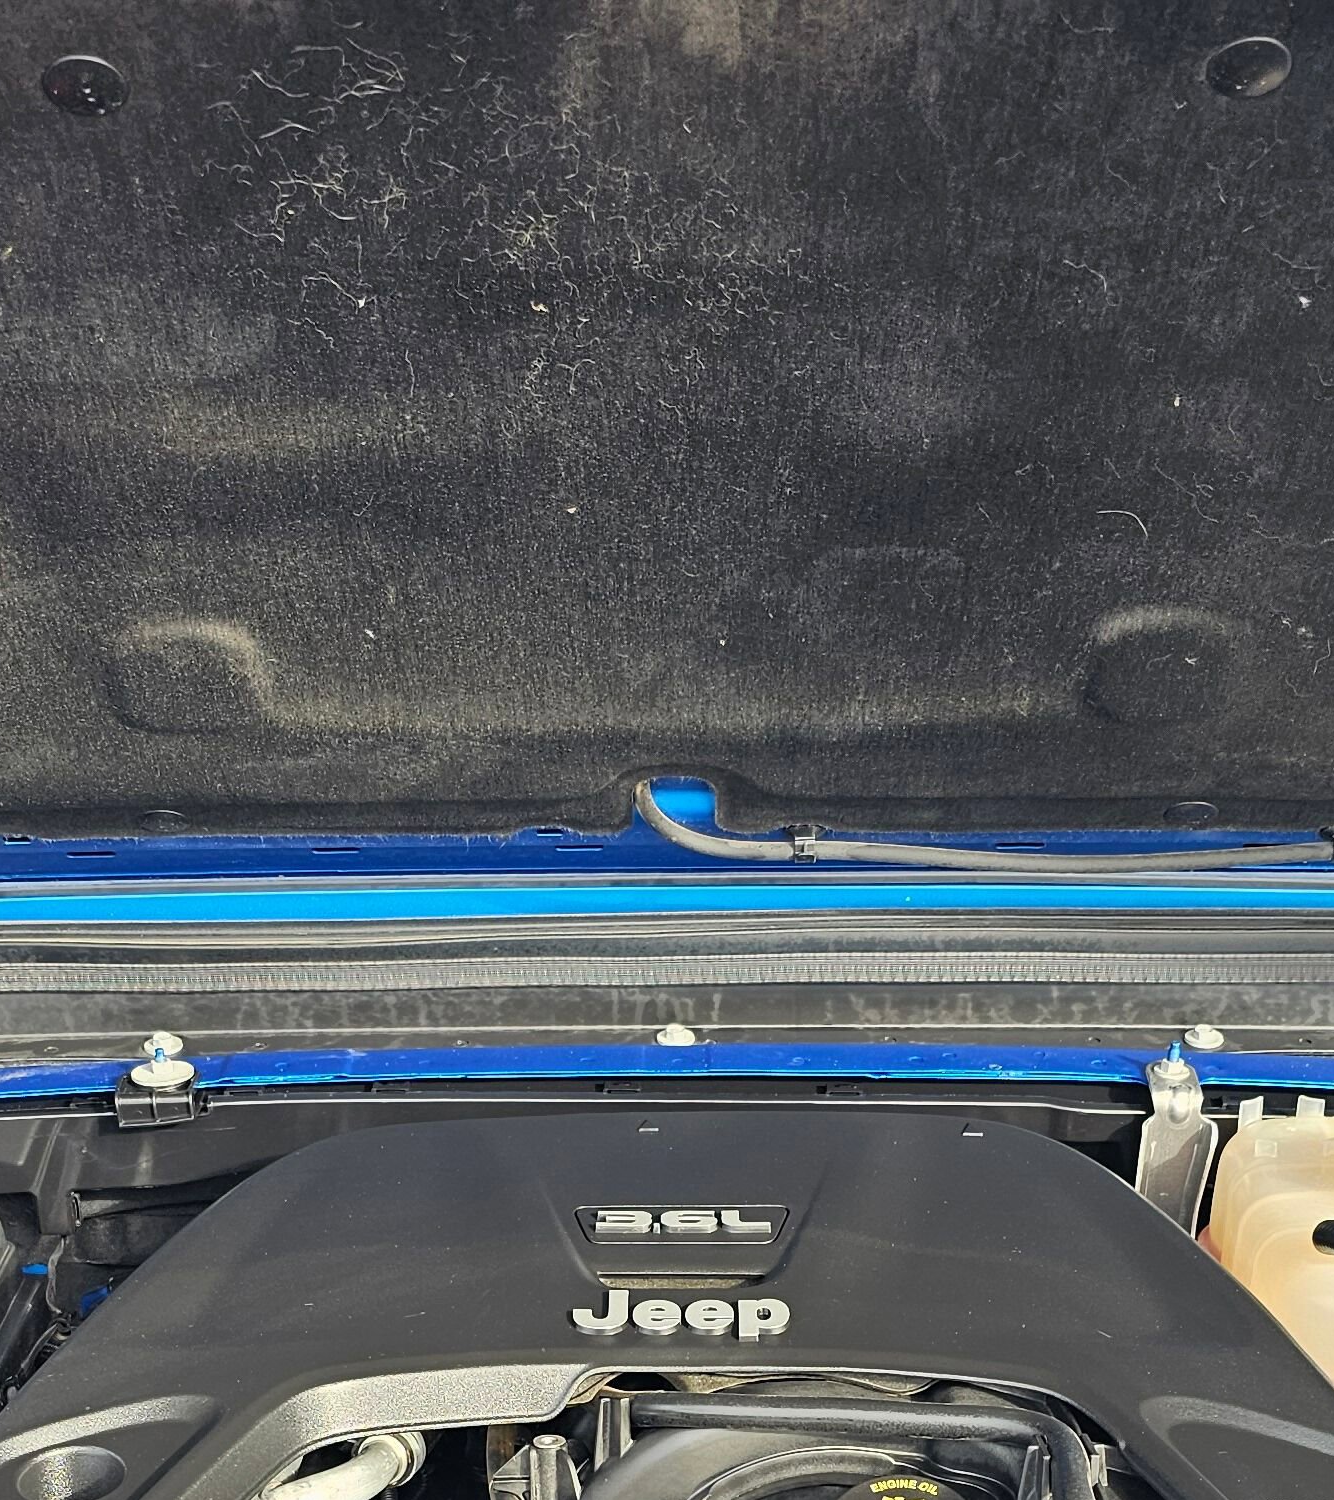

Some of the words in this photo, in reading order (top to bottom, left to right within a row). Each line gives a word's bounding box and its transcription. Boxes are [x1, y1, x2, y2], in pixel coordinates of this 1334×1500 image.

[594, 1210, 772, 1234] 3.6L
[572, 1289, 791, 1342] Jeep
[870, 1479, 918, 1493] ENGINE
[917, 1482, 938, 1496] OIL
